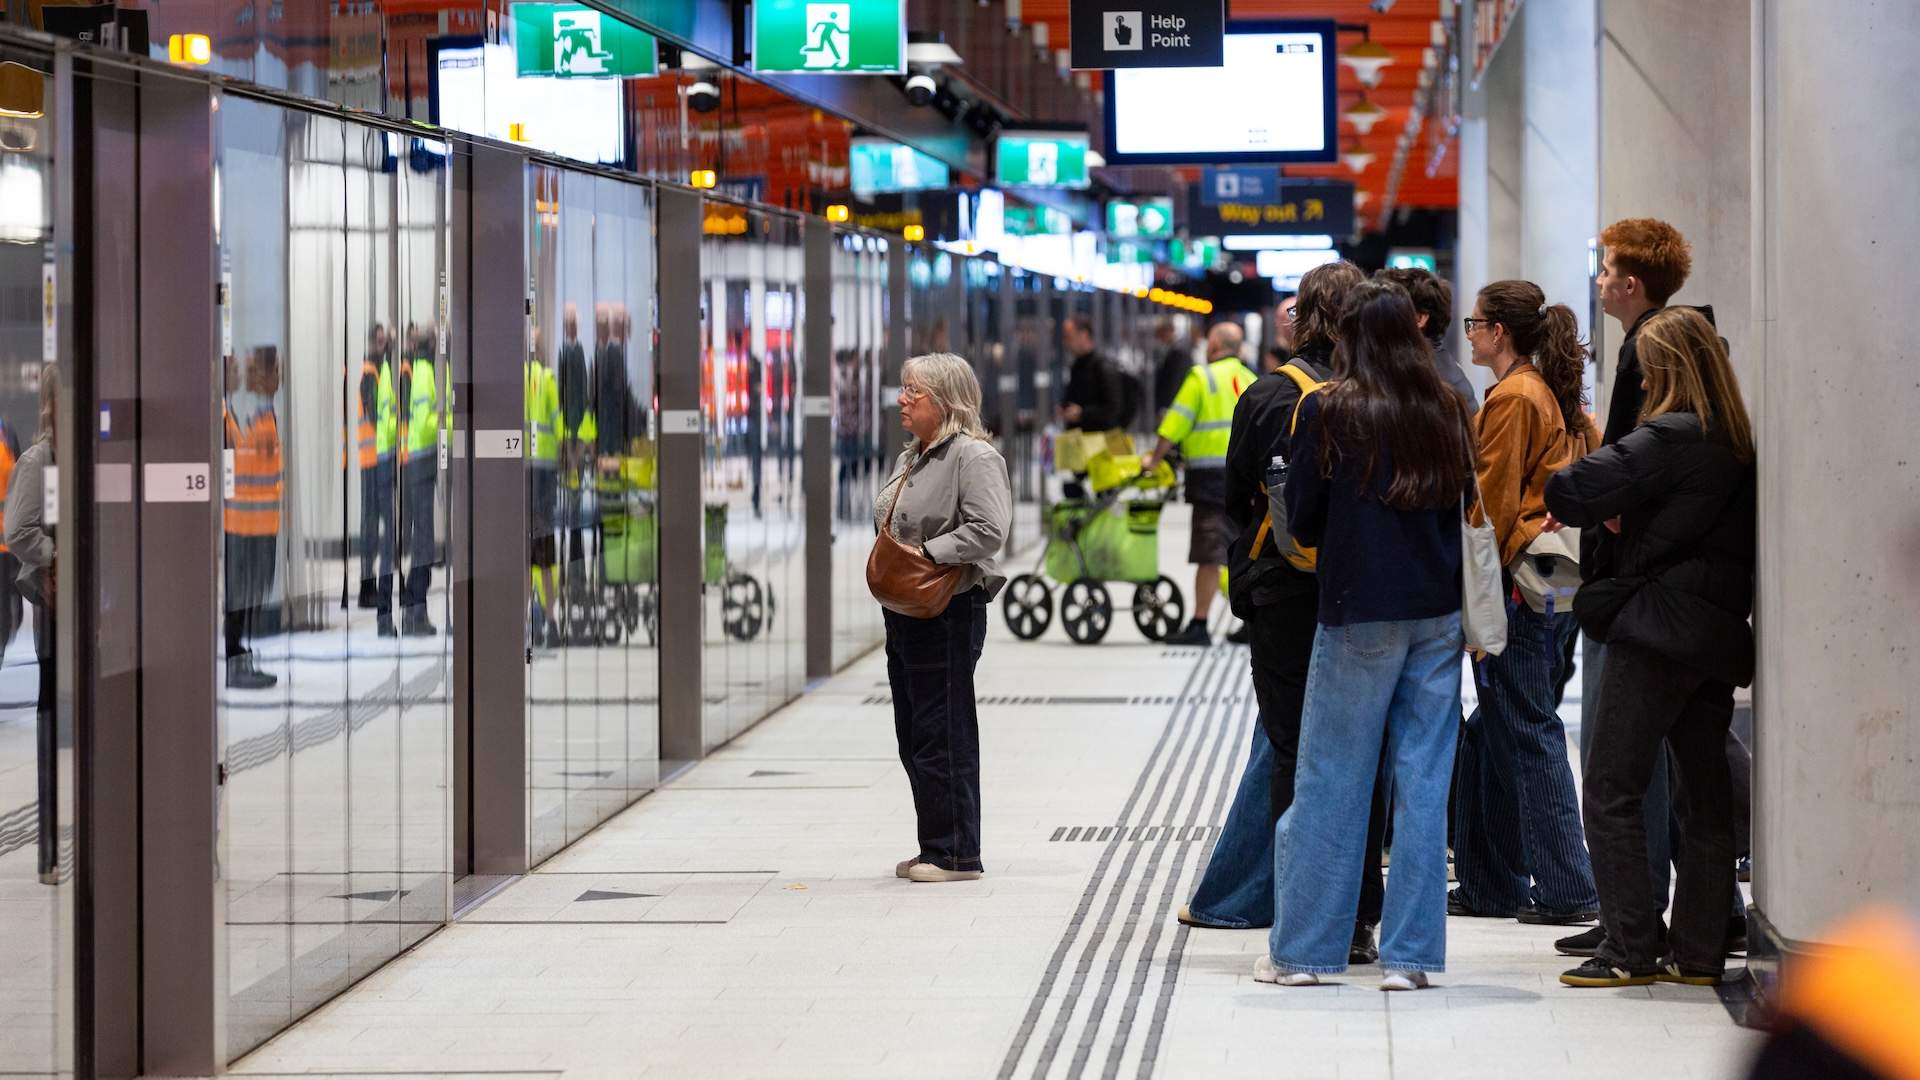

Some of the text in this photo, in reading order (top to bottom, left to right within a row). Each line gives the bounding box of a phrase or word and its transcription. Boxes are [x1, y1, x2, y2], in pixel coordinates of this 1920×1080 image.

[1151, 14, 1186, 31] Help
[1151, 33, 1191, 48] Point
[1218, 203, 1297, 225] Way out
[506, 438, 520, 449] 17
[186, 474, 206, 490] 18
